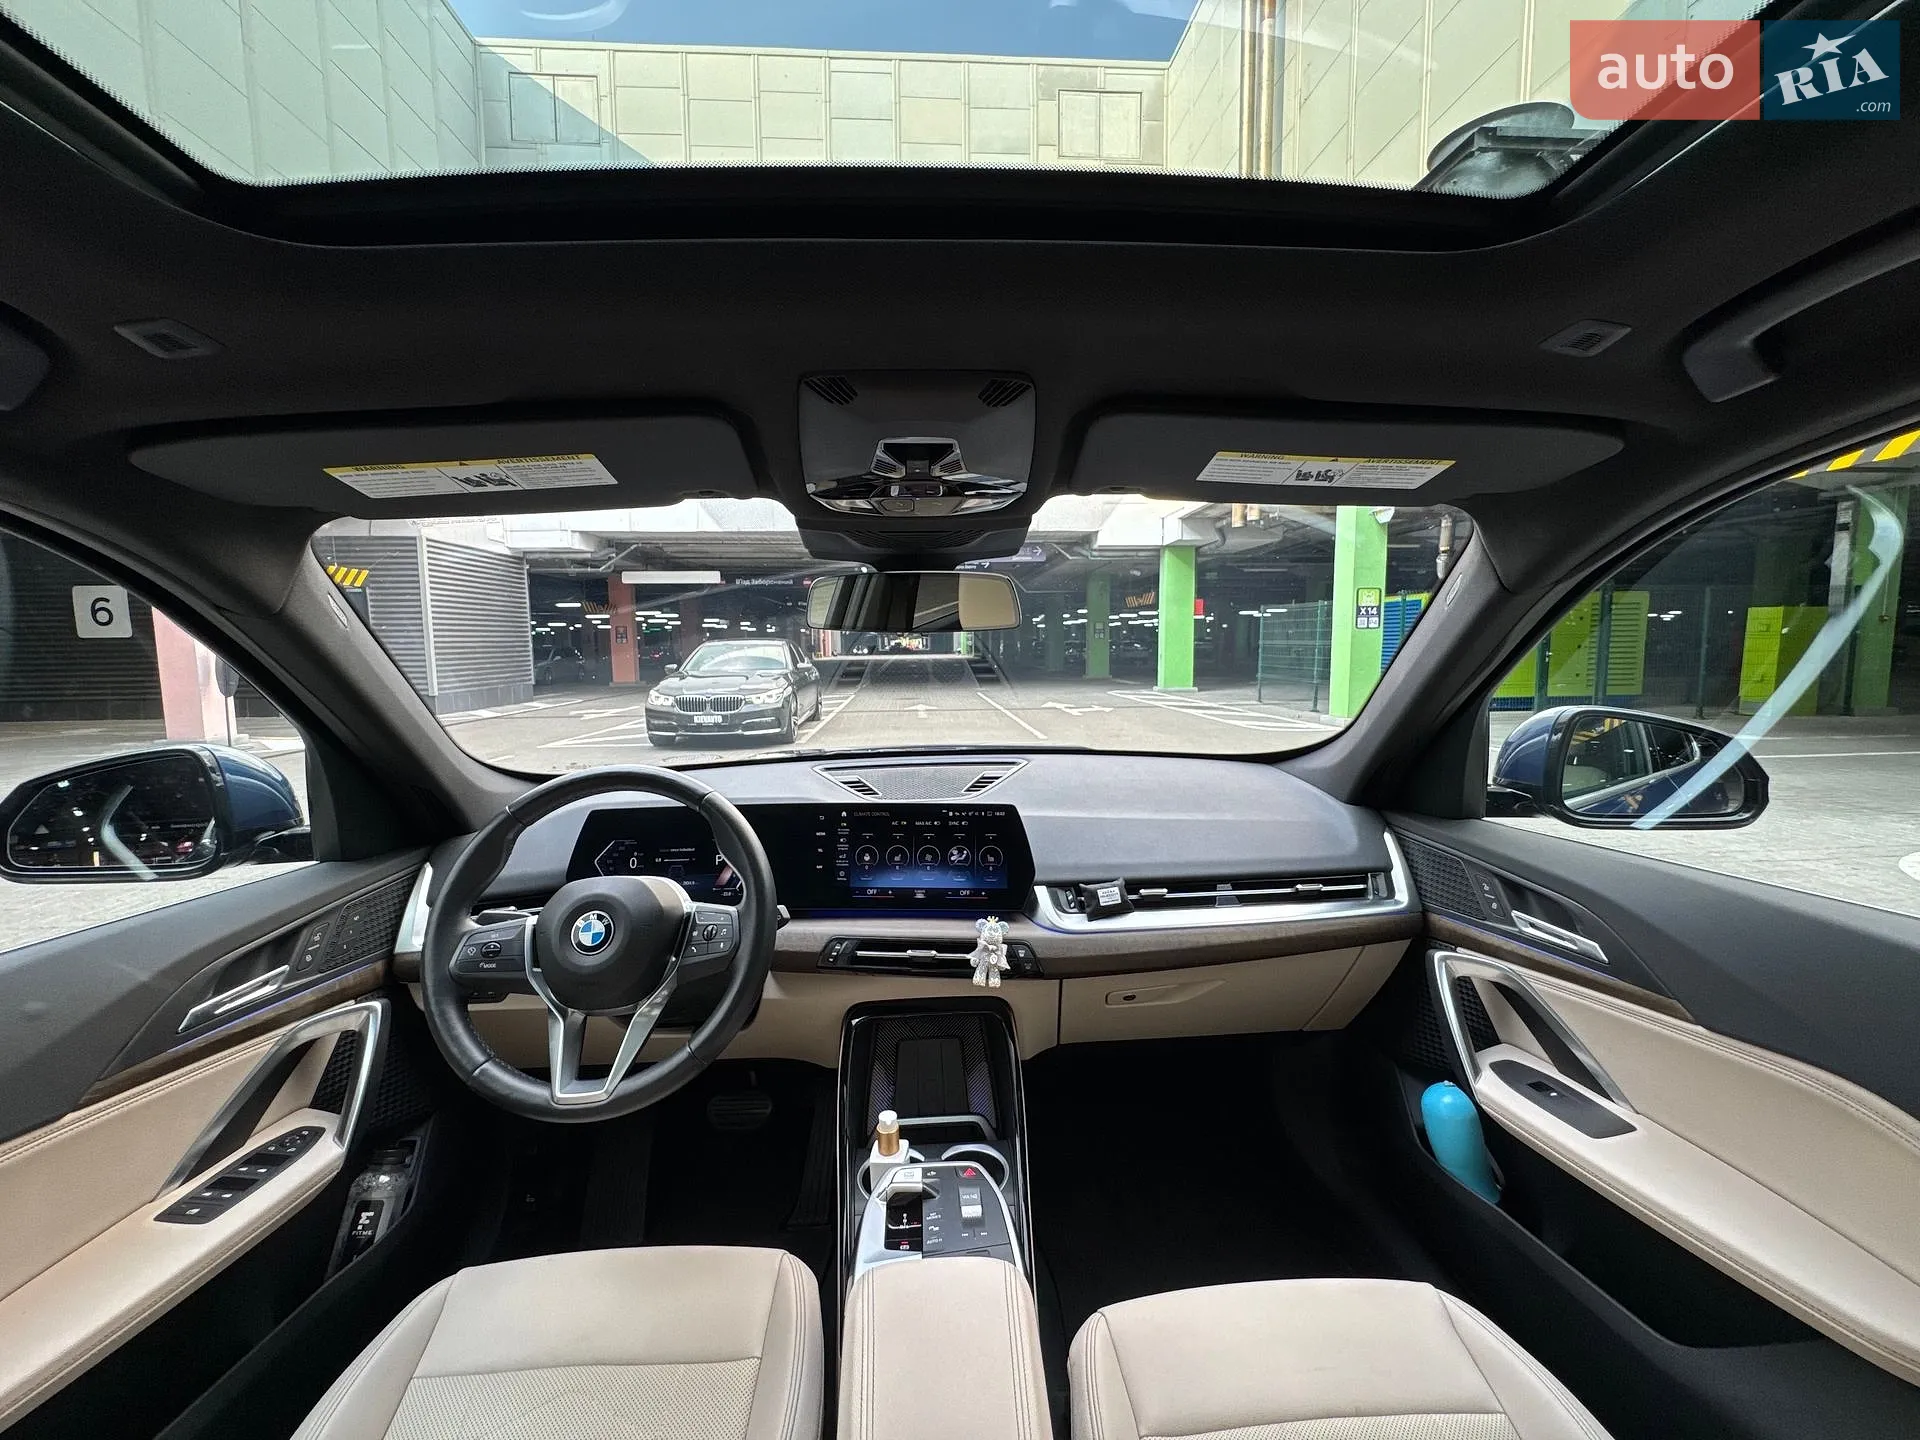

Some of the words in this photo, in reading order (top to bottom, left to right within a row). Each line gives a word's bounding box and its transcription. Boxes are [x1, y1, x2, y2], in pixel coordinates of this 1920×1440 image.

[497, 455, 582, 465] AVERTISSEMENT
[91, 597, 114, 626] 6
[1368, 607, 1377, 615] 14
[629, 857, 637, 869] 0
